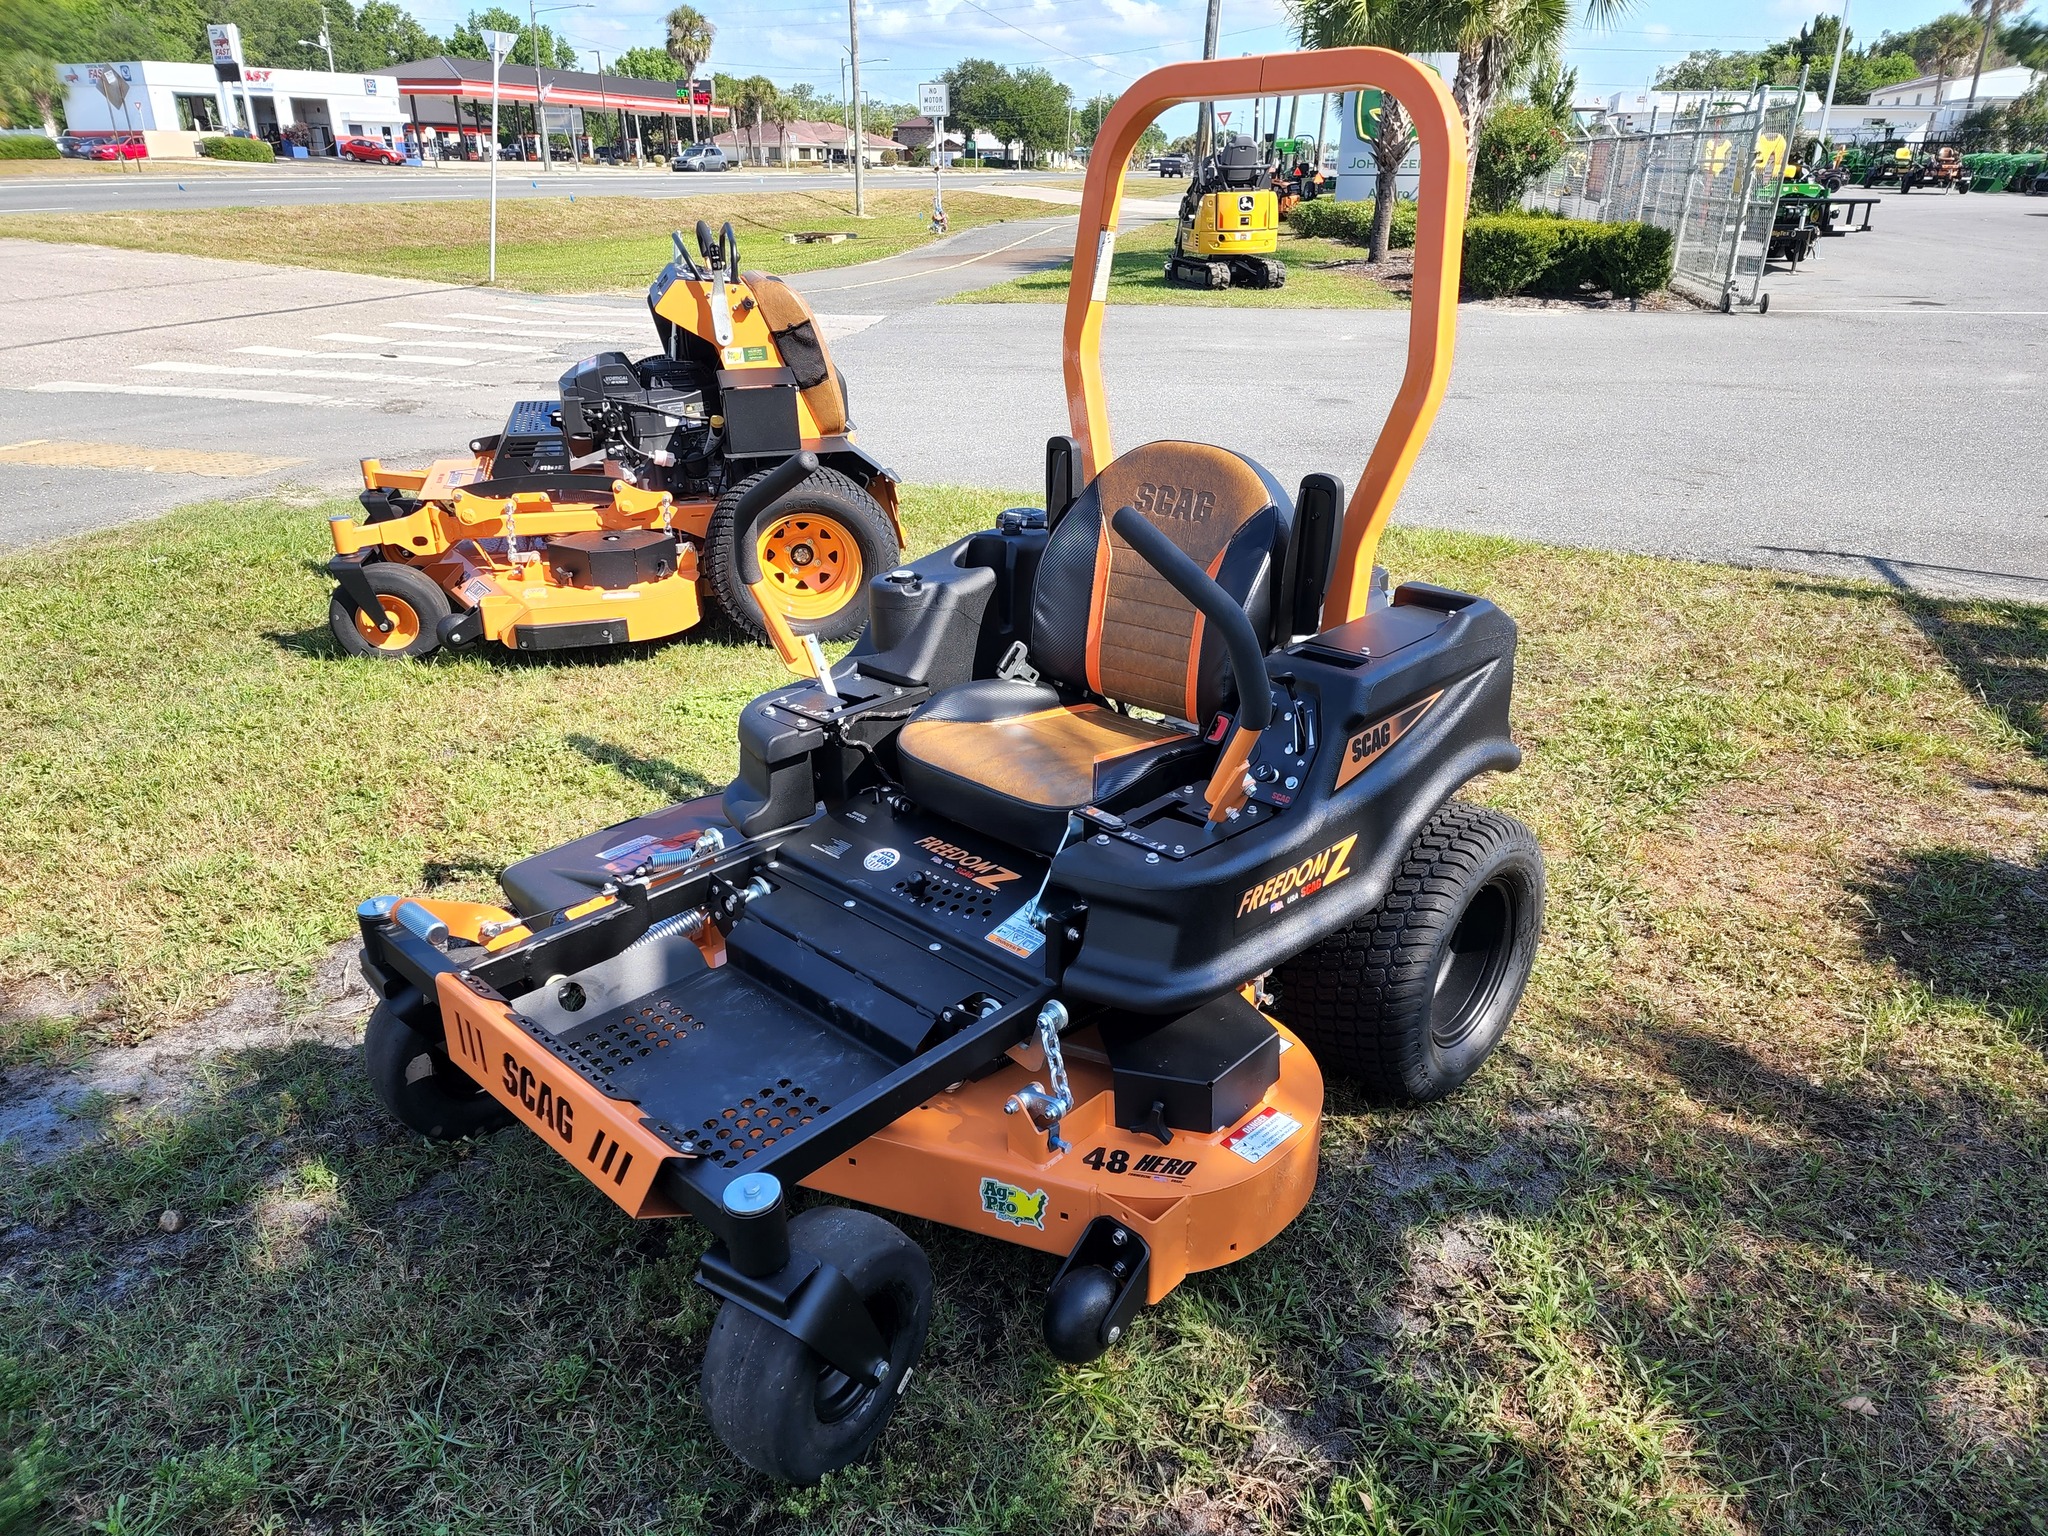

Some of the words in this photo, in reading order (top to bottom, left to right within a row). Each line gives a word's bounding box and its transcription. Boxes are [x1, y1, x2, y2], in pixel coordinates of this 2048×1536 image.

[89, 69, 102, 79] FAS
[1348, 157, 1376, 169] JOH
[1133, 482, 1218, 524] SCAG
[1352, 722, 1391, 764] SCAG
[1271, 791, 1291, 804] SCAG
[913, 836, 999, 873] FREEDOM
[971, 866, 1022, 891] Z
[955, 867, 976, 879] SCAG
[1236, 848, 1331, 919] FREEDOM
[1322, 833, 1359, 887] Z
[1287, 892, 1299, 904] USA
[1300, 878, 1322, 898] SCAG
[502, 1052, 574, 1144] SCAG
[1241, 1113, 1269, 1134] DANGER
[1082, 1147, 1130, 1174] 48
[1133, 1154, 1198, 1177] HERO
[986, 1196, 1017, 1213] Pro
